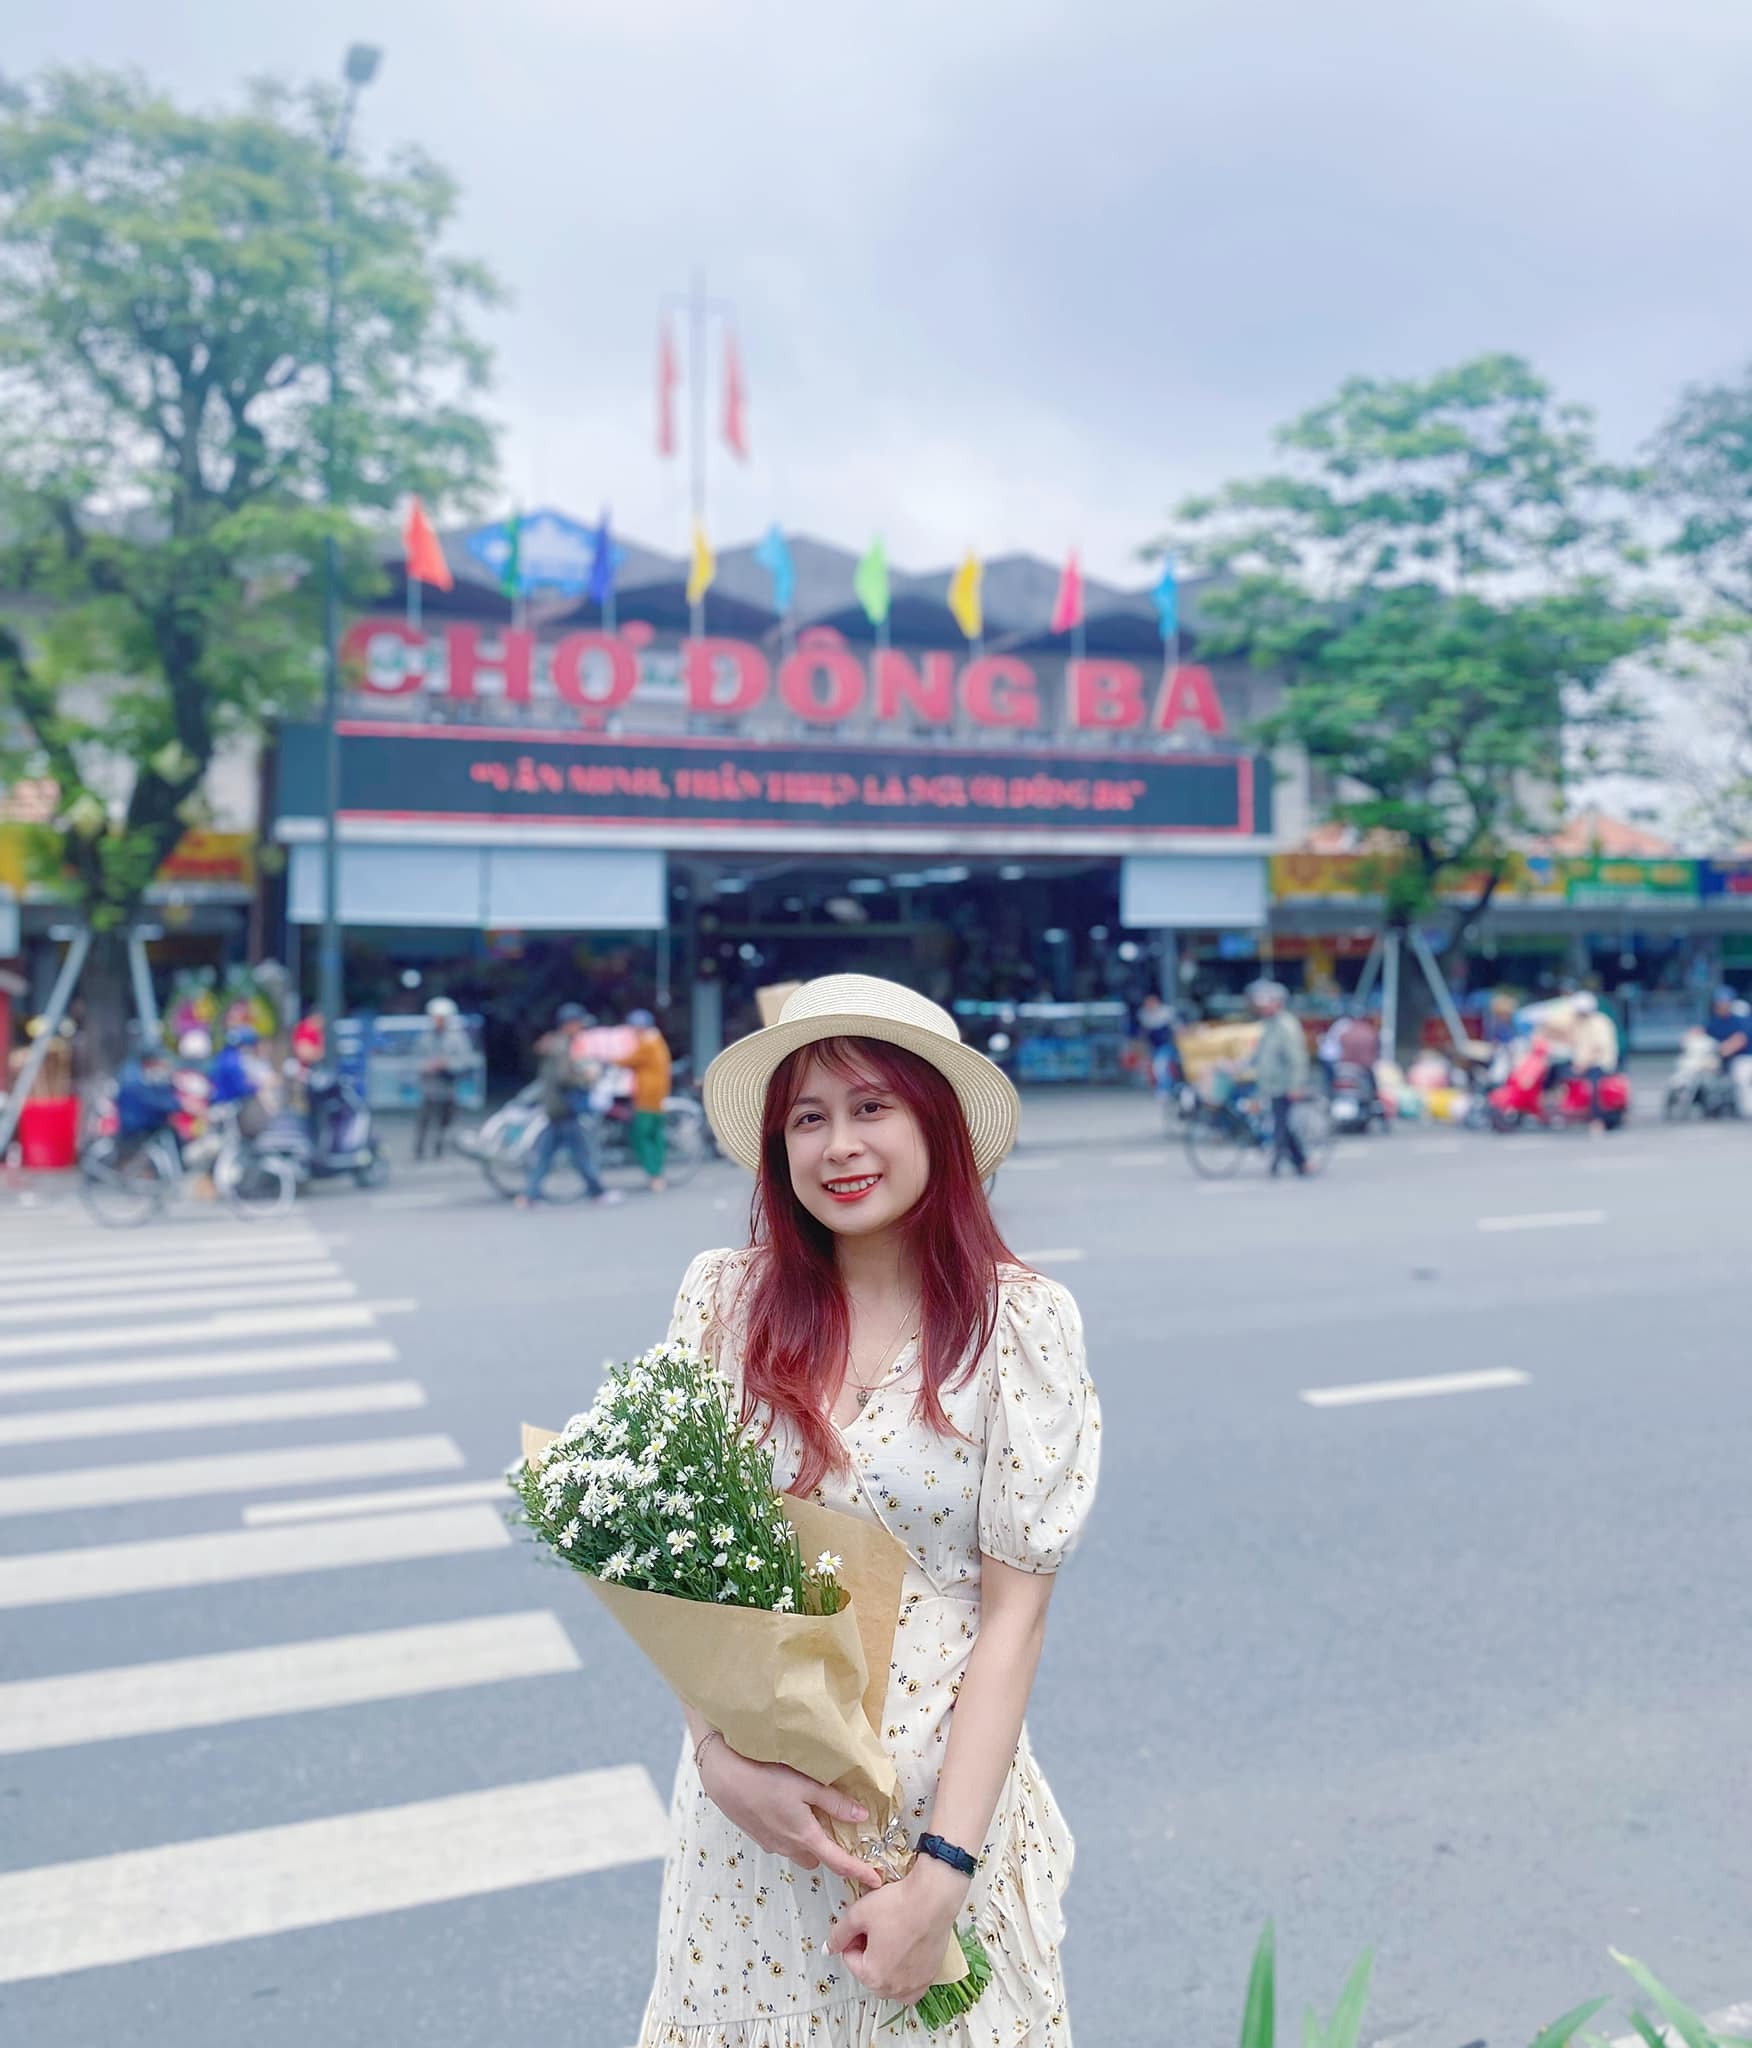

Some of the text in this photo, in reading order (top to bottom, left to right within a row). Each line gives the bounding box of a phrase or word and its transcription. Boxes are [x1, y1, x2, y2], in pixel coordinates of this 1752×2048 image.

[339, 615, 656, 727] CHỢ
[683, 625, 1040, 729] ĐÔNG
[1068, 657, 1227, 734] BA
